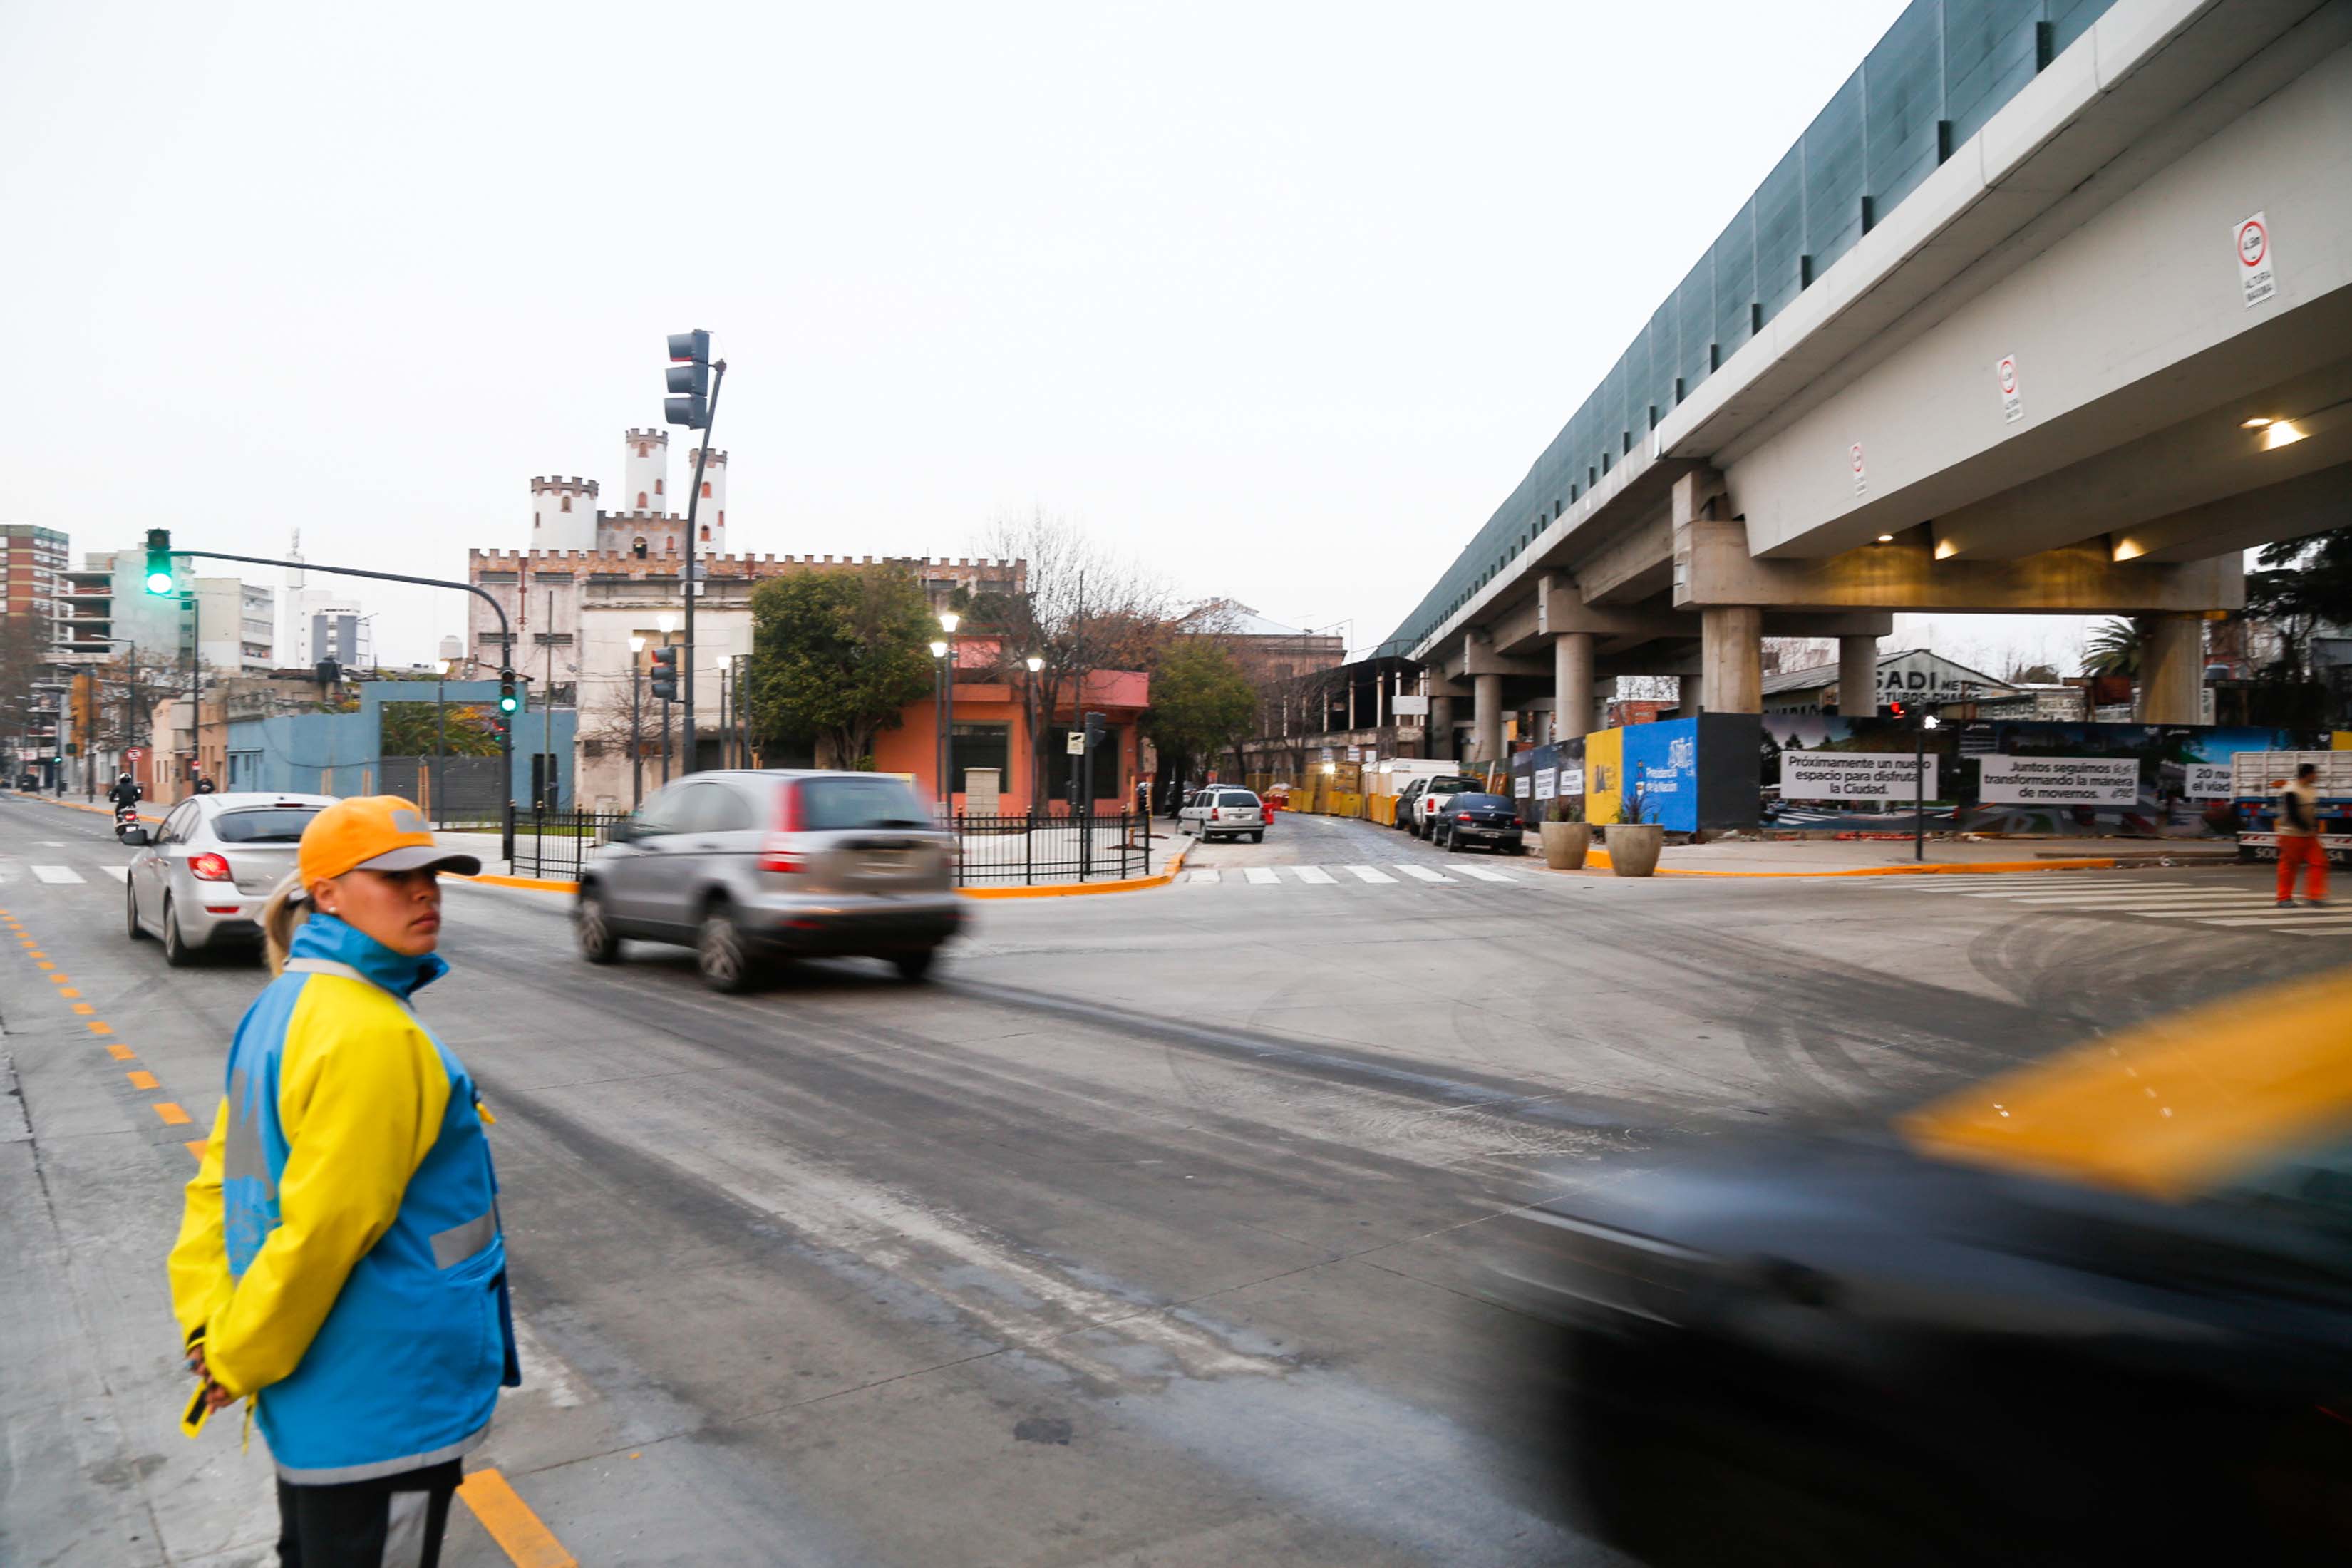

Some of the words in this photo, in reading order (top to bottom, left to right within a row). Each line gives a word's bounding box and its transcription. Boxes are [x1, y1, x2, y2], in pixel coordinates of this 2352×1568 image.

[1788, 755, 1875, 769] Próximamente
[1877, 760, 1893, 769] un
[1894, 760, 1932, 770] nueo
[2009, 762, 2051, 773] Juntos
[2053, 763, 2111, 775] seguimos
[1795, 770, 1842, 783] espacio
[1844, 773, 1872, 783] para
[1873, 770, 1919, 783] disfruta
[1984, 774, 2074, 786] transformando
[2076, 775, 2087, 786] la
[2195, 768, 2214, 779] 20
[2214, 770, 2232, 780] nu
[1830, 783, 1840, 794] la
[1843, 783, 1889, 795] Ciudad.
[2192, 780, 2204, 792] el
[2205, 780, 2231, 792] viad
[2018, 788, 2035, 798] de
